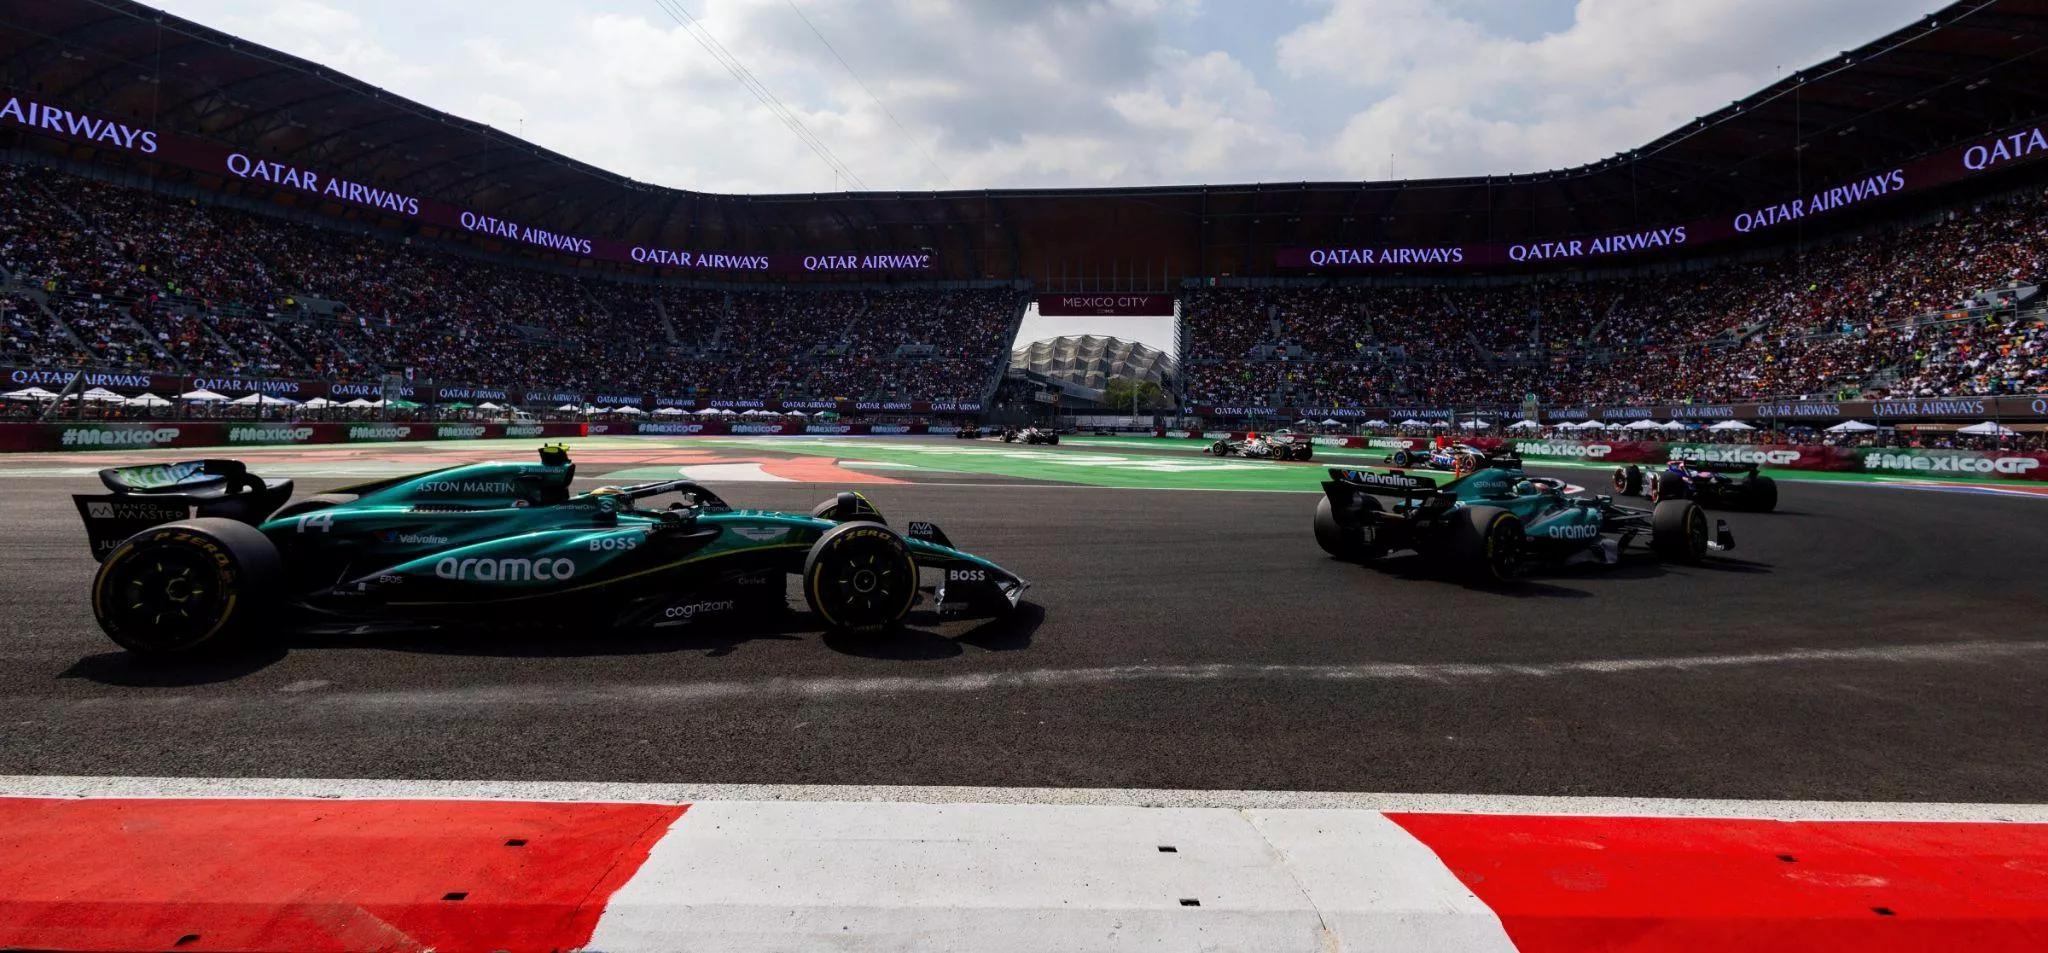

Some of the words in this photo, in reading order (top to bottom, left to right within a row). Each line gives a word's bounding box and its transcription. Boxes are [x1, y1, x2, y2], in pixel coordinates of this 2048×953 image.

[0, 97, 158, 153] AIRWAYS
[1963, 127, 2048, 170] QATA
[227, 153, 318, 192] QATAR
[324, 178, 419, 216] AIRWAYS
[1734, 199, 1805, 232] QATAR
[1809, 168, 1905, 215] AIRWAYS
[461, 211, 518, 240] QATAR
[522, 227, 591, 254] AIRWAYS
[1509, 241, 1583, 262] QATAR
[1589, 226, 1686, 255] AIRWAYS
[631, 247, 691, 266] QATAR
[696, 253, 768, 270] AIRWAYS
[803, 255, 857, 271] QATAR
[861, 255, 929, 269] AIRWAYS
[1310, 249, 1374, 266] QATAR
[1379, 247, 1463, 264] AIRWAYS
[1063, 297, 1114, 308] MEXICO
[1118, 297, 1149, 308] CITY
[194, 378, 241, 391] QATAR
[332, 383, 369, 396] QATAR
[440, 388, 469, 399] QATAR
[782, 401, 806, 409] QATAR
[856, 402, 880, 410] QATAR
[931, 403, 955, 411] QATAR
[1215, 407, 1242, 415] QATAR
[1671, 407, 1697, 418] QAAR
[1699, 406, 1734, 417] AIRWAYS
[1793, 404, 1840, 416] AIRWAYS
[1873, 401, 1918, 416] QATAR
[1921, 400, 1984, 415] AIRWAYS
[1626, 408, 1652, 418] AIRWAYS
[62, 428, 180, 445] #MexicoGP
[229, 427, 313, 441] #MexicoGP
[350, 426, 410, 439] #MexicoGP
[1514, 441, 1612, 458] #MexicoGP
[1864, 451, 2040, 474] #MexicoGP
[1358, 471, 1418, 487] Valvoline
[416, 481, 460, 493] ASTON
[463, 481, 515, 493] MARTIN
[114, 510, 184, 520] MASTER
[297, 512, 334, 534] 14
[398, 533, 448, 545] Valvoline
[1549, 524, 1597, 540] aramco
[589, 537, 637, 552] BOSS
[435, 556, 576, 581] aramco
[949, 569, 985, 581] BOSS
[665, 599, 735, 618] cognizant
